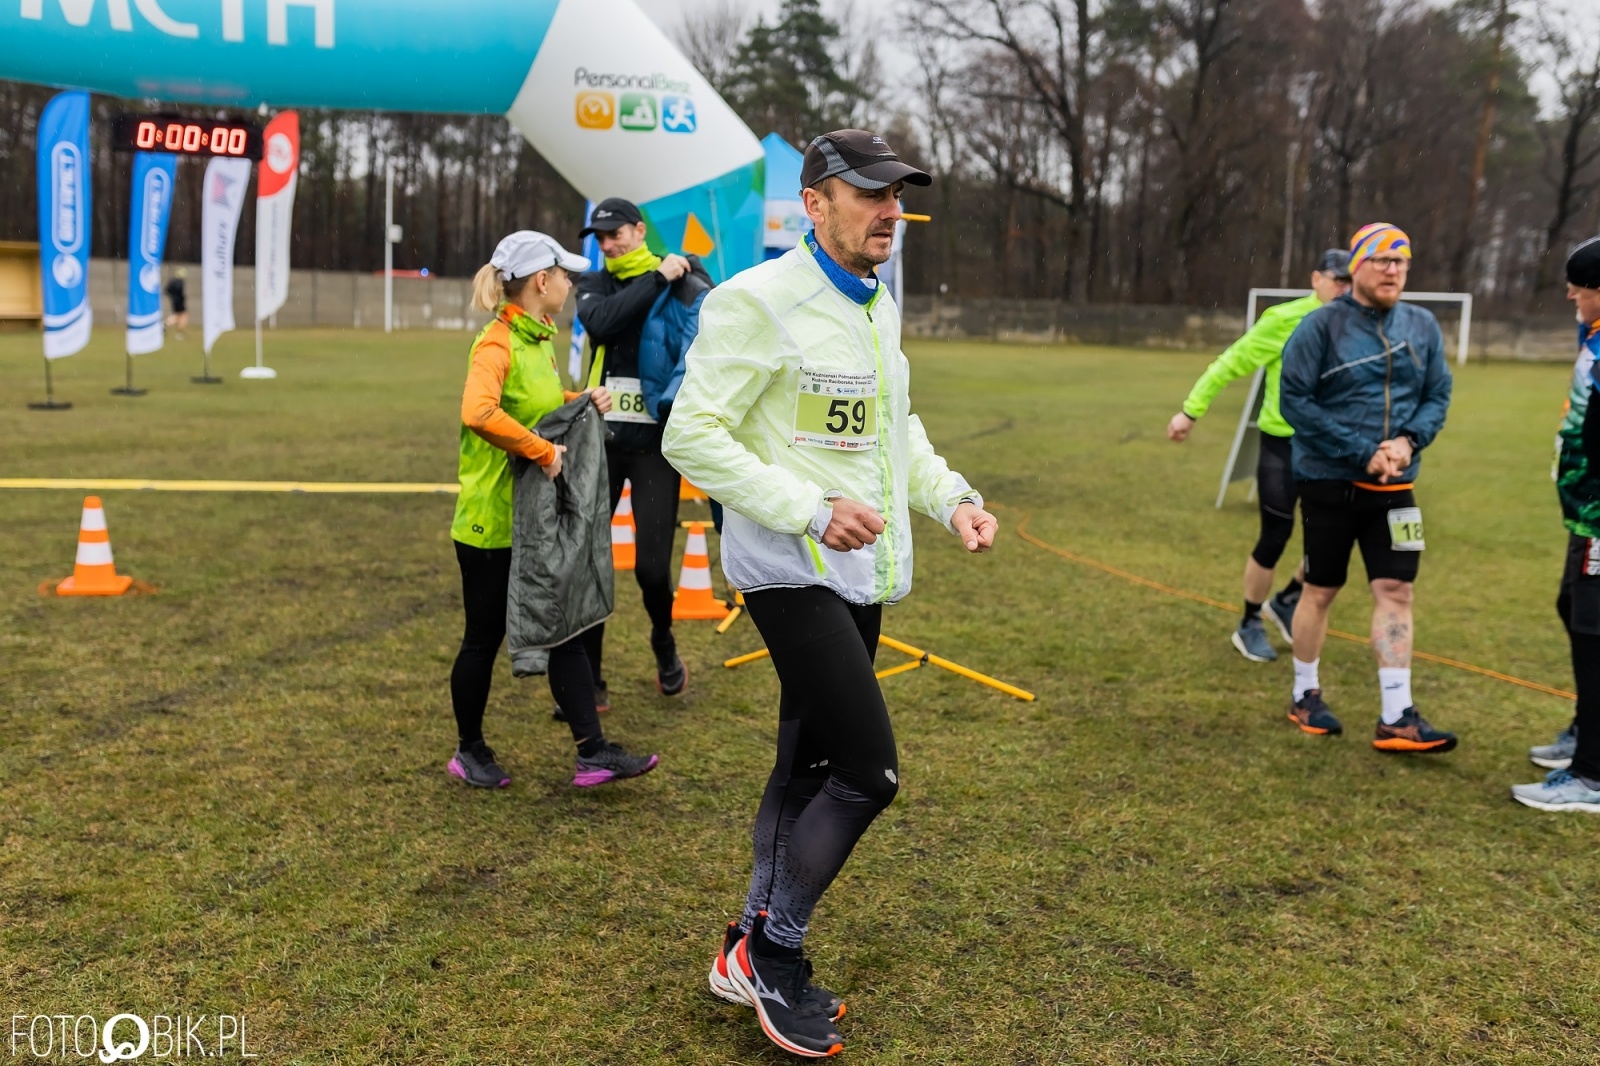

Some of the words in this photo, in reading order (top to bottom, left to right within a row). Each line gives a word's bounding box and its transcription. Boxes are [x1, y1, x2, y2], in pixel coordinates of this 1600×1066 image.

[620, 393, 644, 413] 68
[825, 399, 866, 435] 59
[1402, 523, 1423, 540] 18
